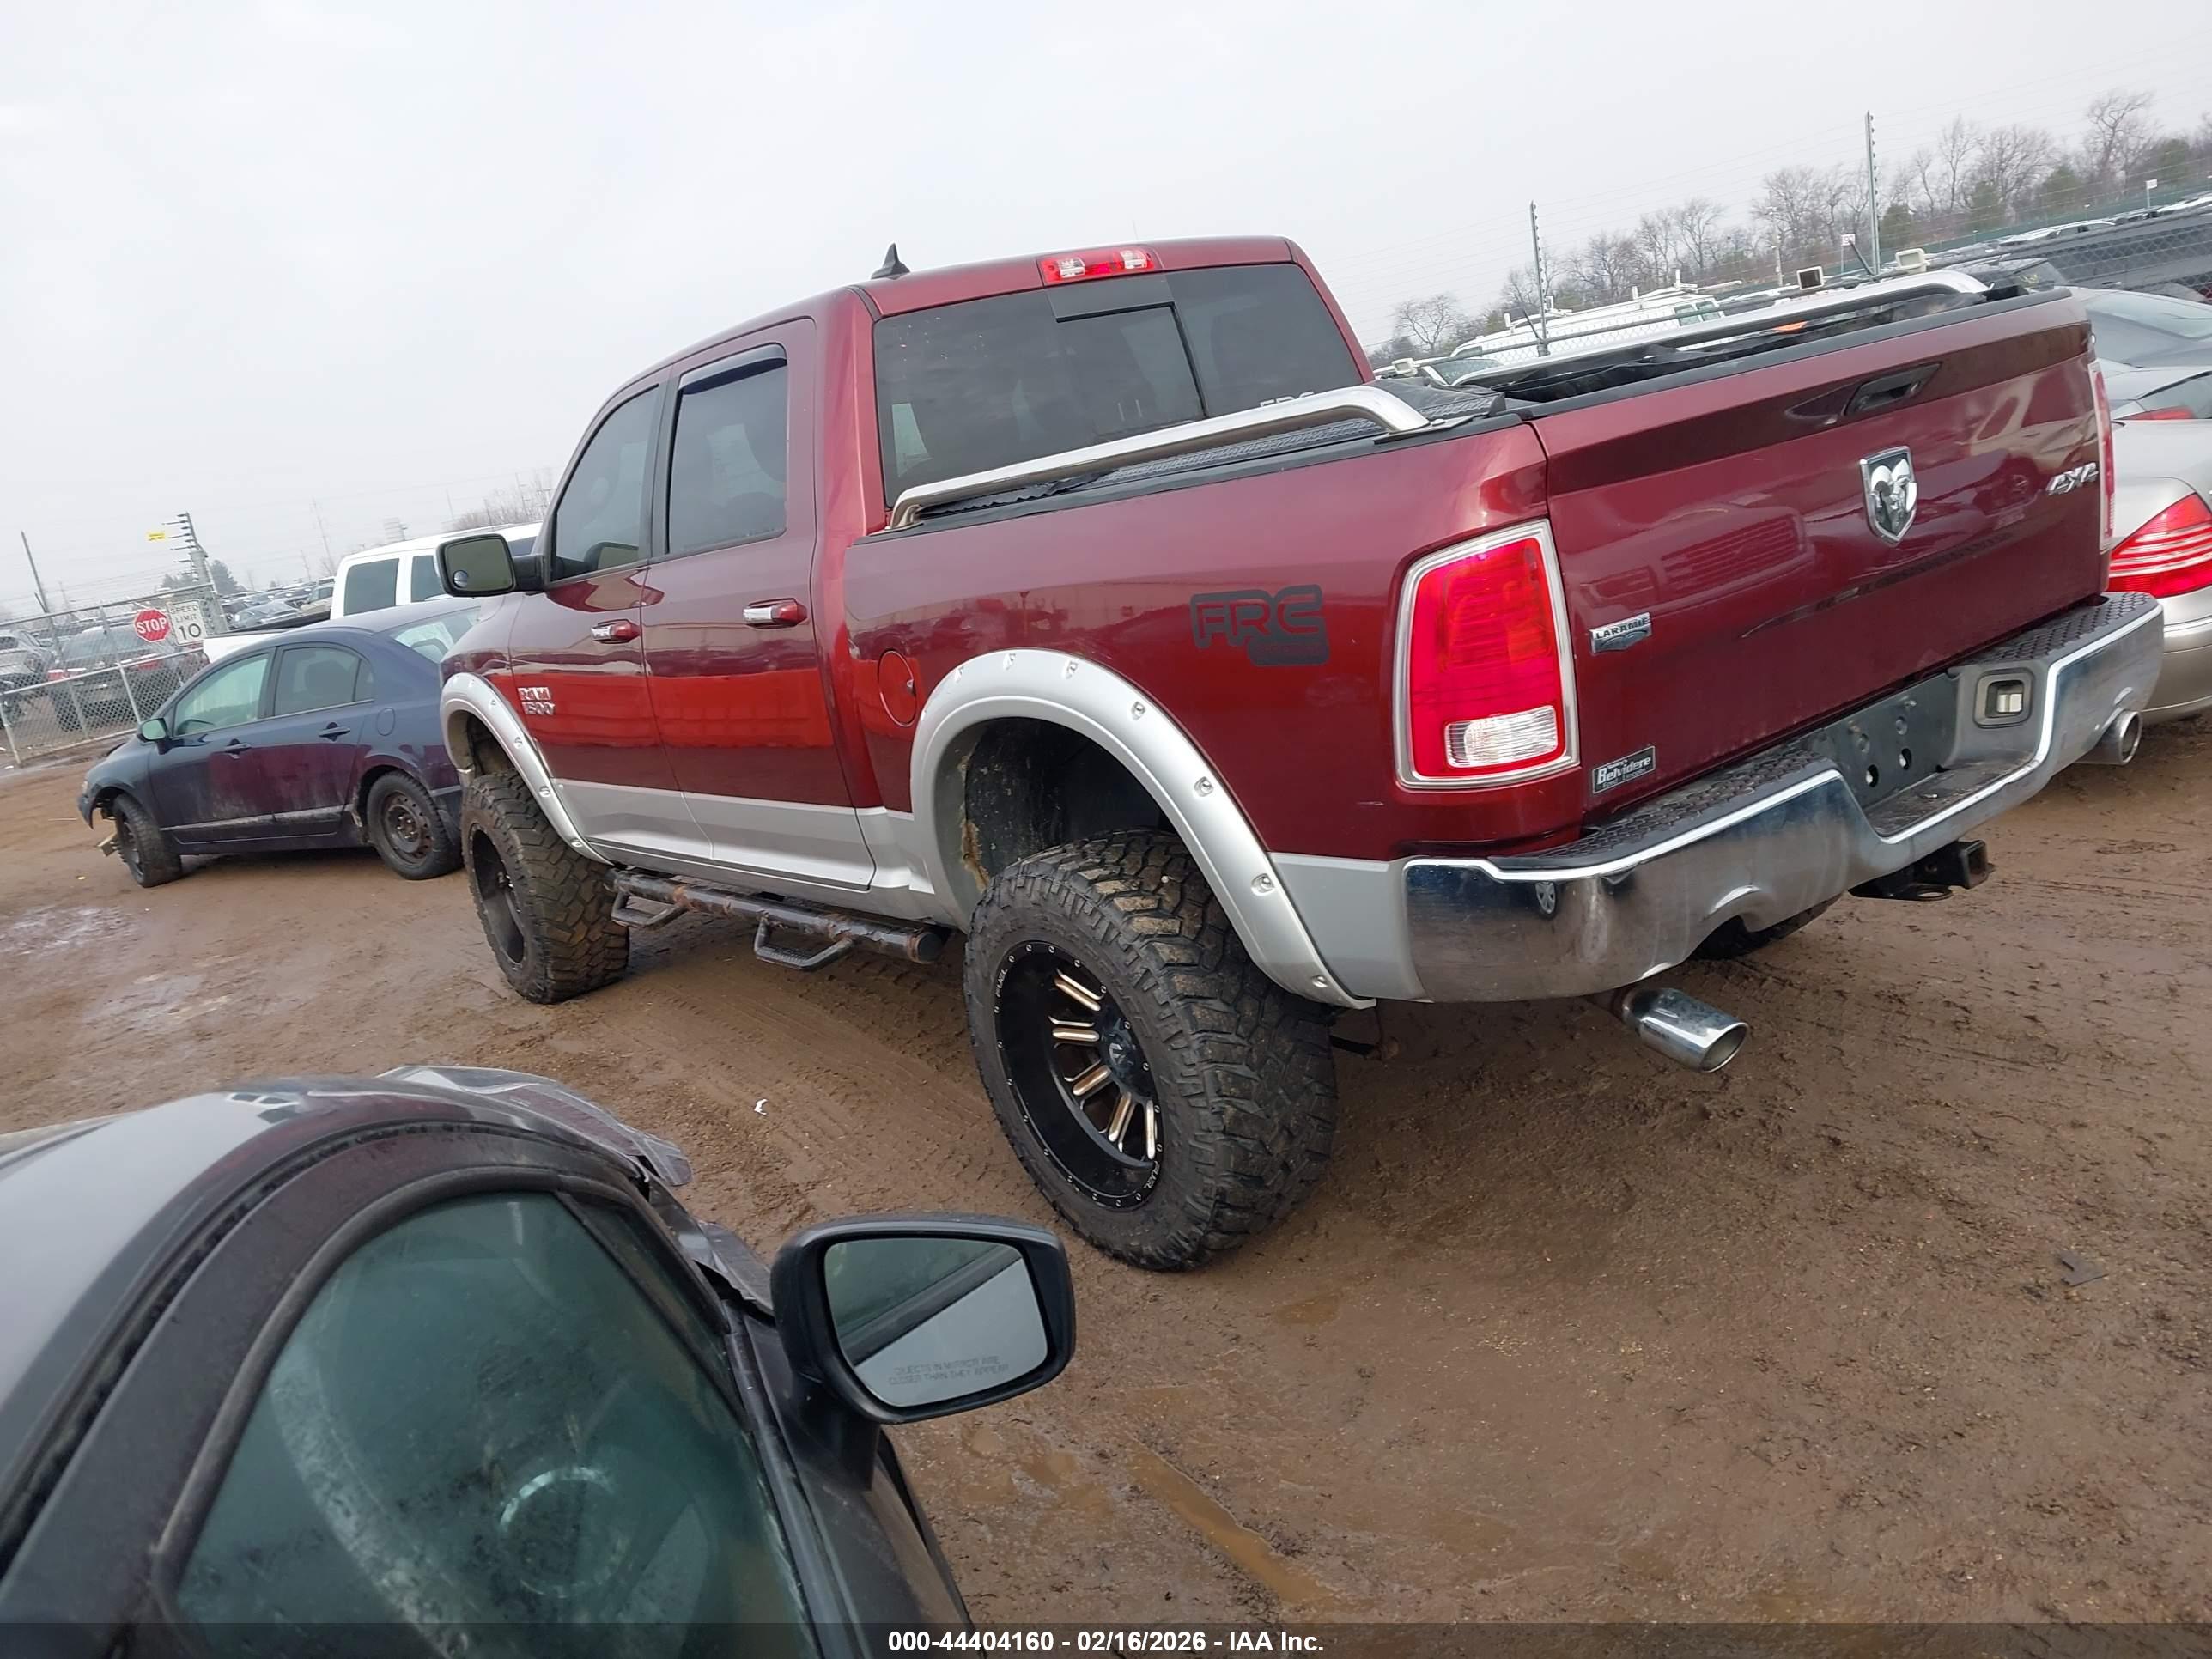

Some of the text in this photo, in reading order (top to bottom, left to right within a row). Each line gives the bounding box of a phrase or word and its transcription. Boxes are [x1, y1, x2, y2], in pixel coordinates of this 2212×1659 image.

[171, 604, 198, 615] SPEED
[175, 613, 197, 623] LIMIT
[136, 617, 167, 635] STOP
[179, 623, 202, 641] 10
[1596, 616, 1651, 640] LARAMIE
[517, 687, 551, 701] RAM
[1597, 757, 1651, 785] Belvidere
[996, 969, 1009, 998] FUEL
[1143, 1160, 1160, 1189] FUEL
